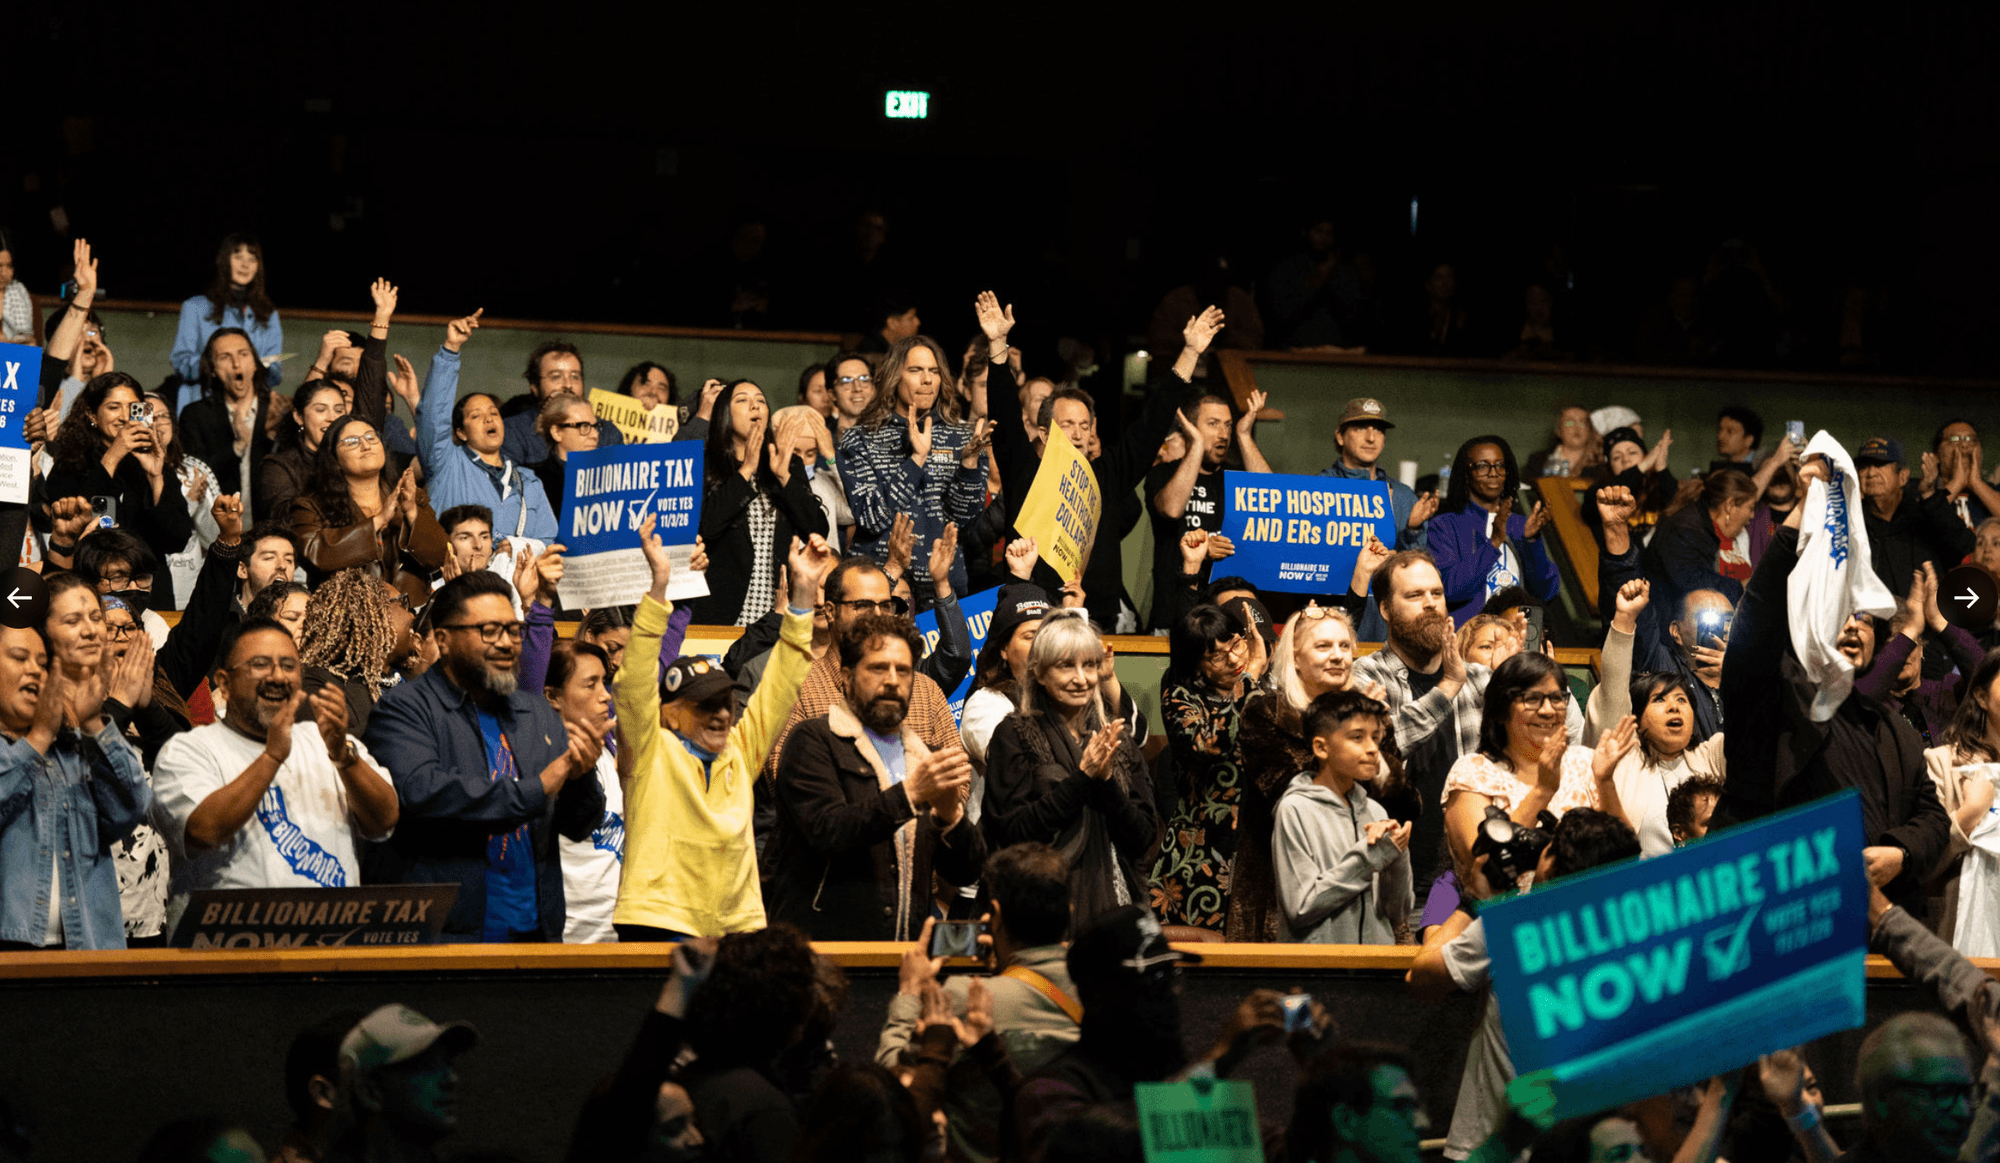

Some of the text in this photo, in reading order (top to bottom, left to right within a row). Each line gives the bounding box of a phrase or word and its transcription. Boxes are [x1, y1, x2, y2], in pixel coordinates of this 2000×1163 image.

[885, 90, 930, 119] EXIT
[575, 458, 694, 498] BILLIONAIRE TAX
[1070, 459, 1089, 493] STOP
[657, 496, 693, 512] VOTE YES
[1186, 500, 1215, 514] TIME
[1235, 487, 1385, 519] KEEP HOSPITALS
[572, 499, 624, 538] NOW
[660, 513, 689, 528] 11/3/26
[1185, 515, 1201, 527] TO
[1242, 517, 1375, 547] AND ERs OPEN
[1279, 571, 1304, 580] NOW
[201, 899, 433, 925] BILLIONAIRE TAX
[1513, 826, 1841, 975] BILLIONAIRE TAX
[191, 932, 310, 949] NOW
[363, 931, 419, 943] VOTE YES
[1527, 937, 1693, 1039] NOW
